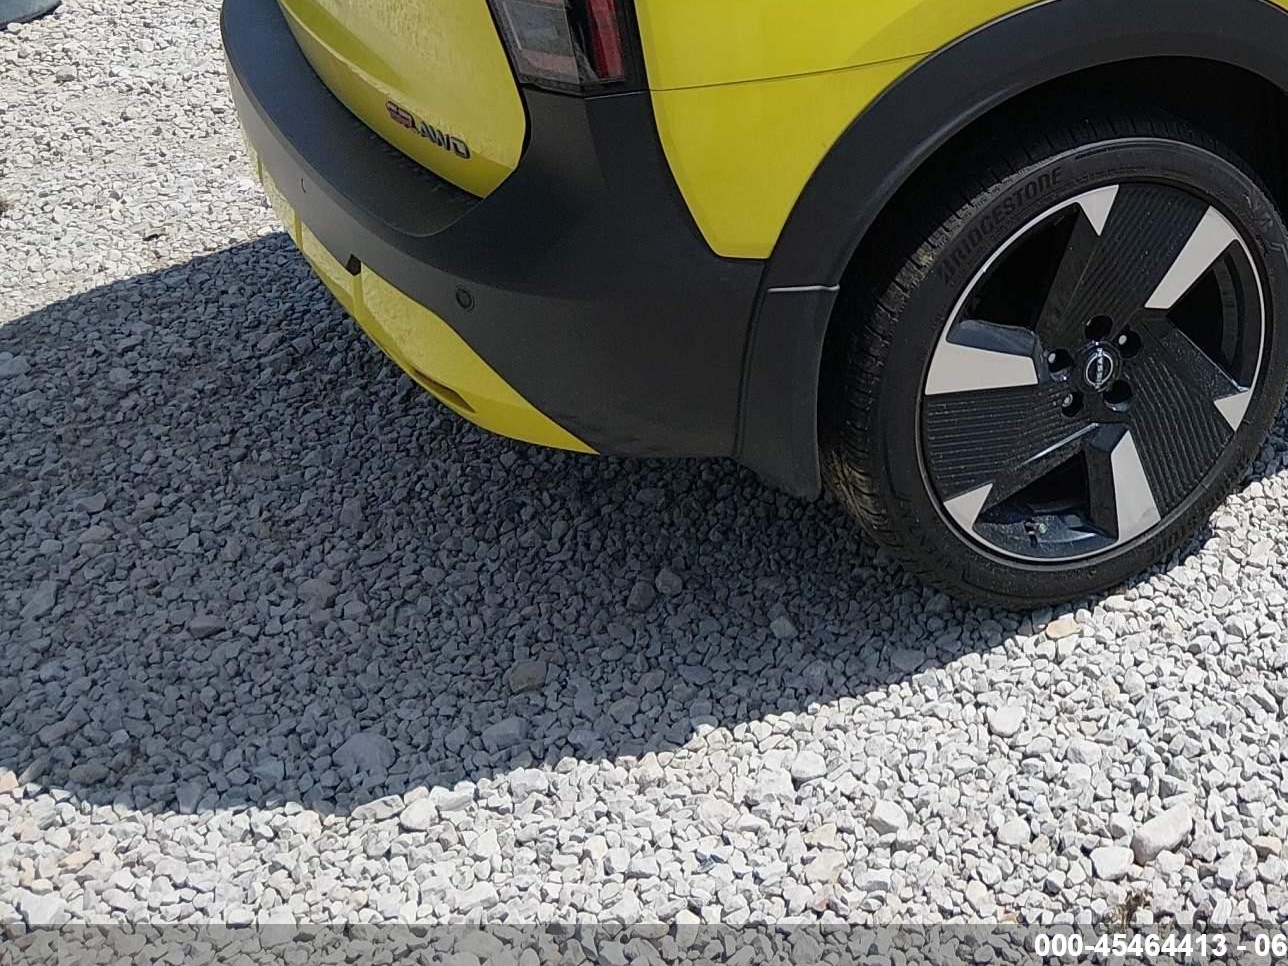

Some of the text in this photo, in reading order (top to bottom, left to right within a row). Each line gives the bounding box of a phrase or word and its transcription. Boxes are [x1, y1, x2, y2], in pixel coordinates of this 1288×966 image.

[419, 121, 471, 160] AWD
[937, 165, 1063, 284] BRIDGESTONE
[1095, 347, 1104, 390] NISSAN
